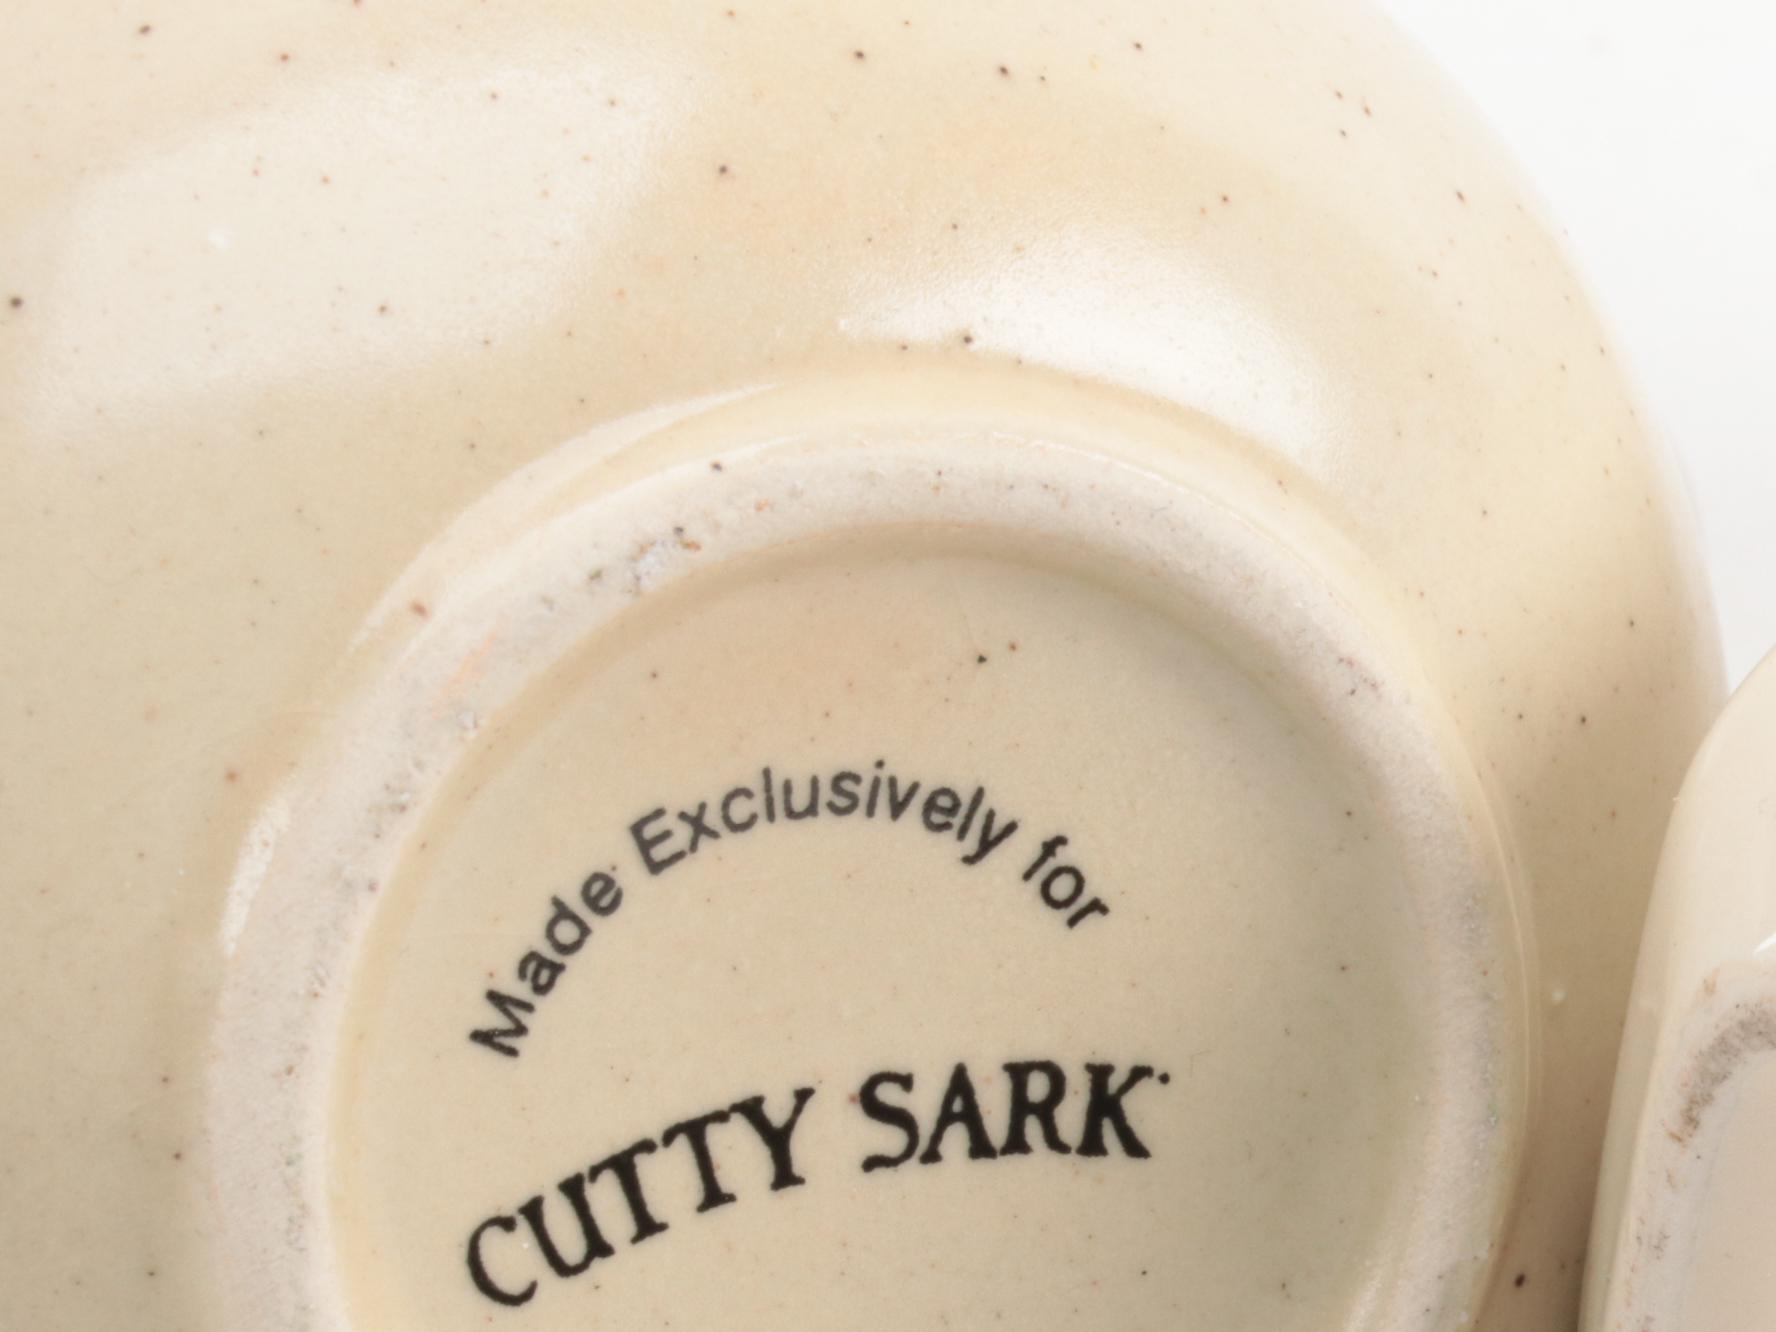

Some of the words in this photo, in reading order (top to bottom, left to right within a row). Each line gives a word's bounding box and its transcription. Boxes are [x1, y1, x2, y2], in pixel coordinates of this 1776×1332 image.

[469, 868, 623, 1058] Made
[629, 760, 1018, 874] Exclusively
[1022, 835, 1110, 930] for
[465, 1086, 815, 1307] CUTTY
